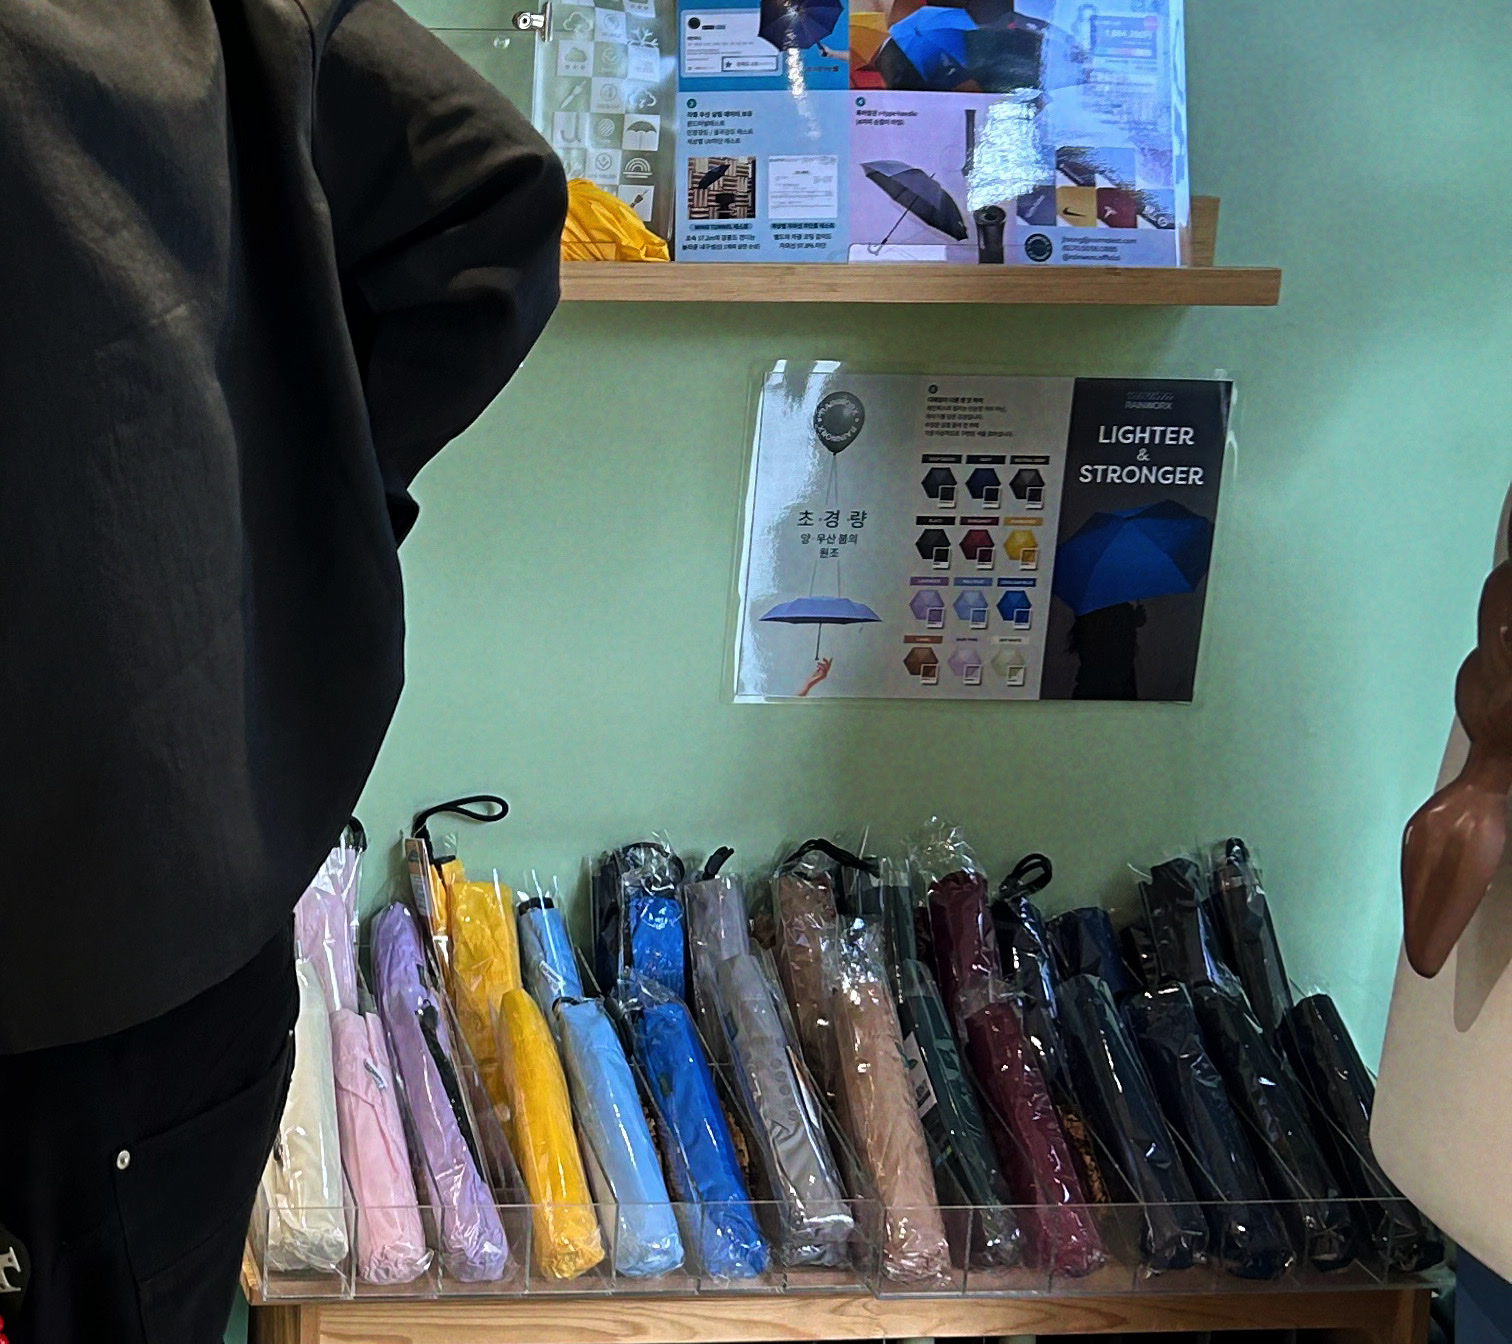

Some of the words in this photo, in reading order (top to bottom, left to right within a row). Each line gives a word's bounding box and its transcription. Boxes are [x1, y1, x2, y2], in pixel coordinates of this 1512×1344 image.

[1098, 425, 1195, 445] LIGHTER
[1136, 447, 1150, 461] &
[1078, 464, 1205, 485] STRONGER
[819, 547, 839, 559] 원조
